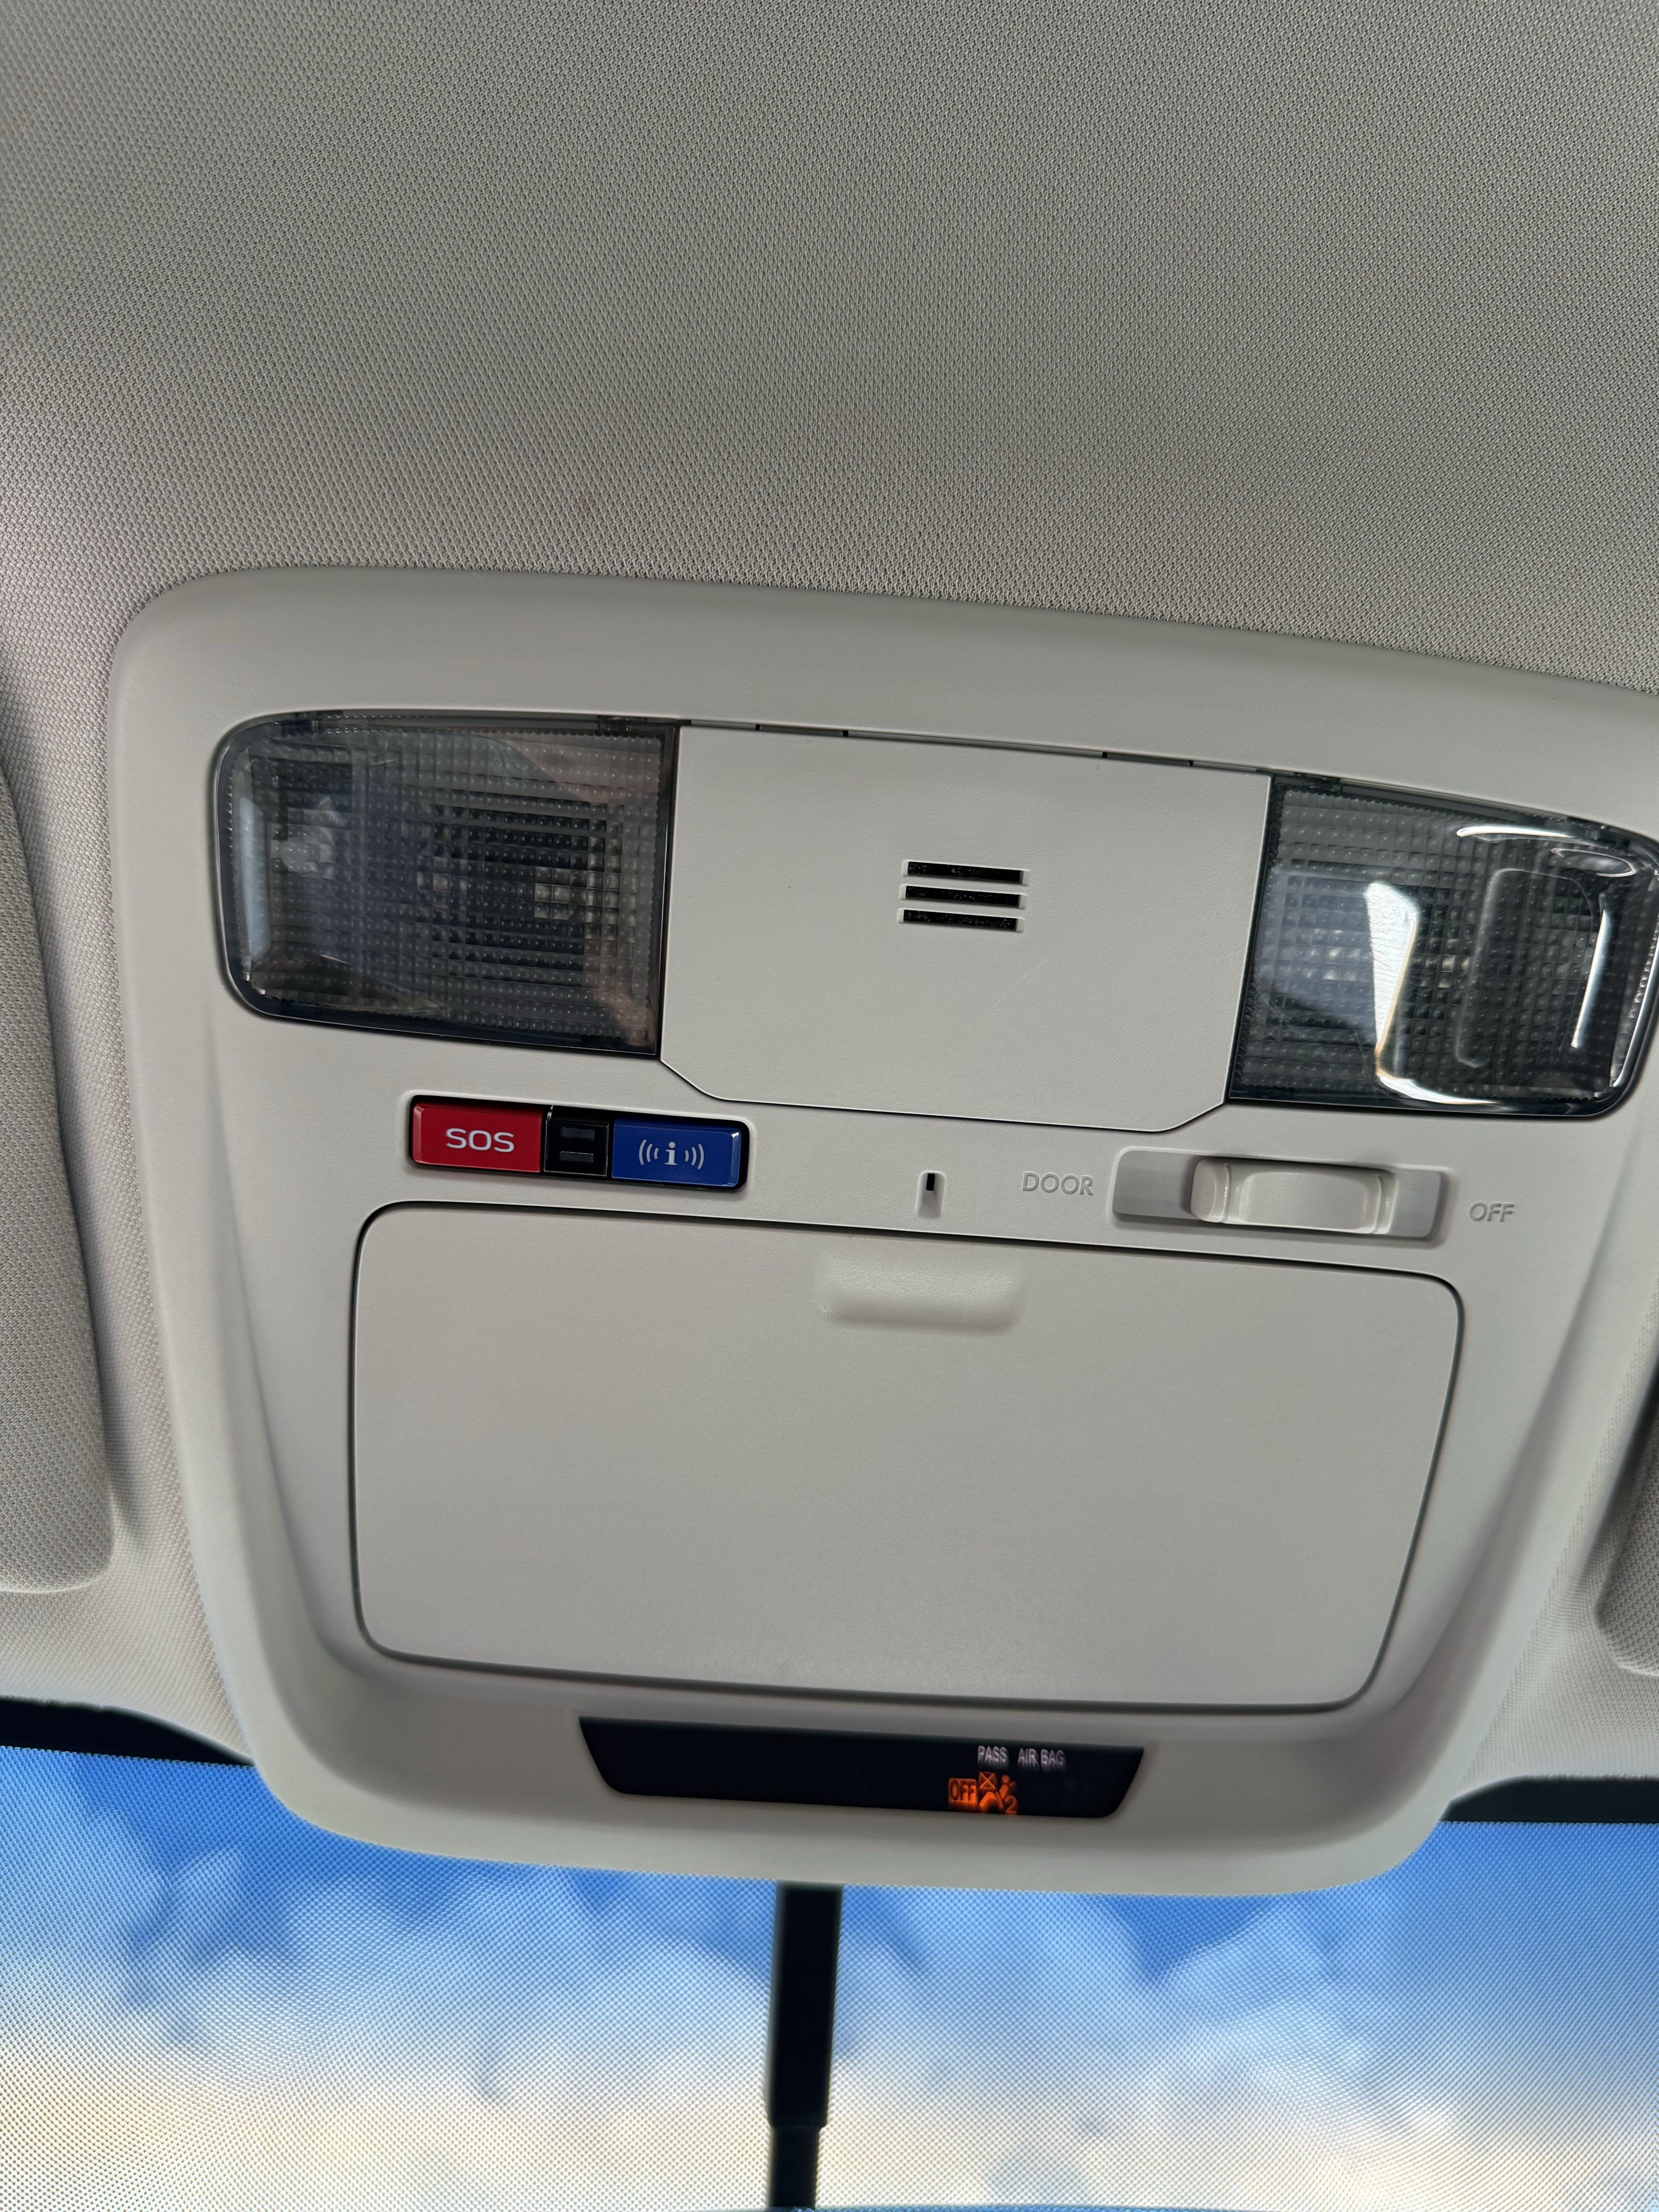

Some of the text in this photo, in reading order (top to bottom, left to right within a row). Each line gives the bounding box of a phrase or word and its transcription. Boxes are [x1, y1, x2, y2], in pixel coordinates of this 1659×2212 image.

[446, 1128, 515, 1154] SOS
[1022, 1171, 1094, 1196] DOOR
[1467, 1201, 1515, 1223] OFF
[977, 1745, 1067, 1767] PASS AIR BAG
[949, 1779, 977, 1802] OFF
[1004, 1795, 1018, 1815] 2
